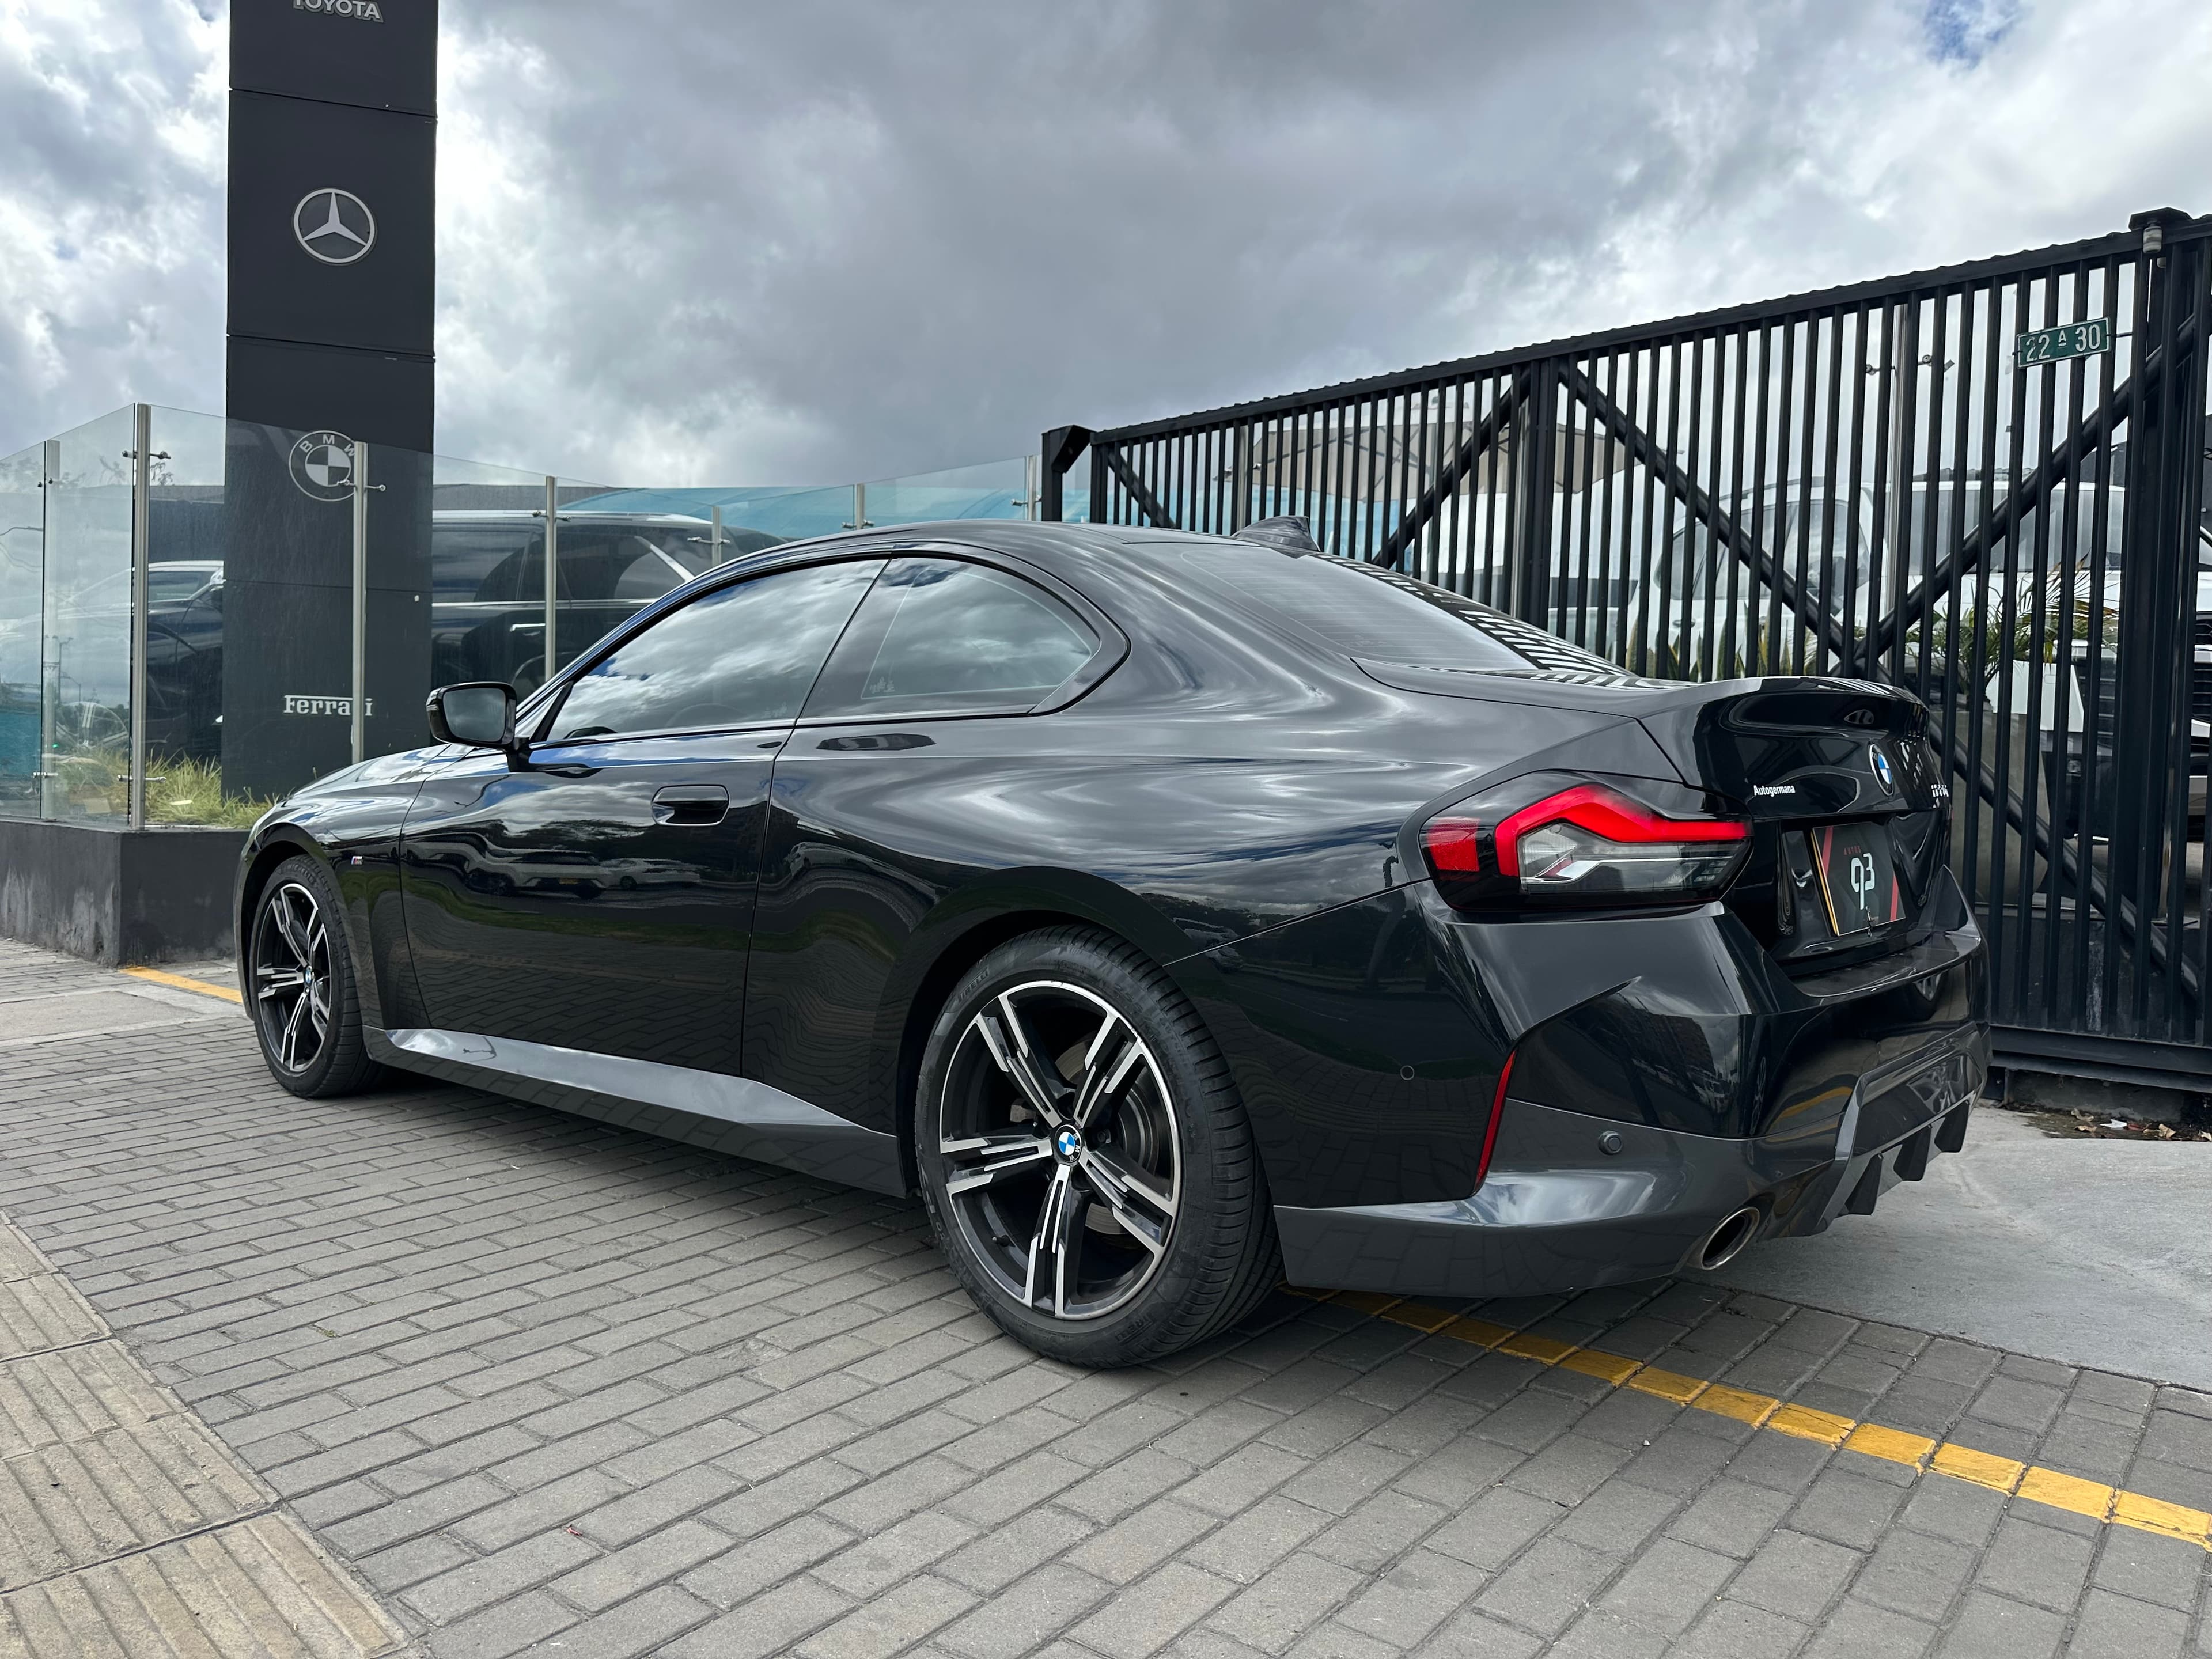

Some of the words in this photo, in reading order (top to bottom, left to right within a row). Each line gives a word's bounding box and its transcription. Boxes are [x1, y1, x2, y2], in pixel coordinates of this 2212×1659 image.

[2025, 334, 2051, 362] 22
[2075, 324, 2101, 352] 30
[299, 434, 355, 457] BMW
[283, 694, 373, 716] Ferrai
[1753, 785, 1796, 797] Autogermana
[1068, 1132, 1081, 1162] BMW
